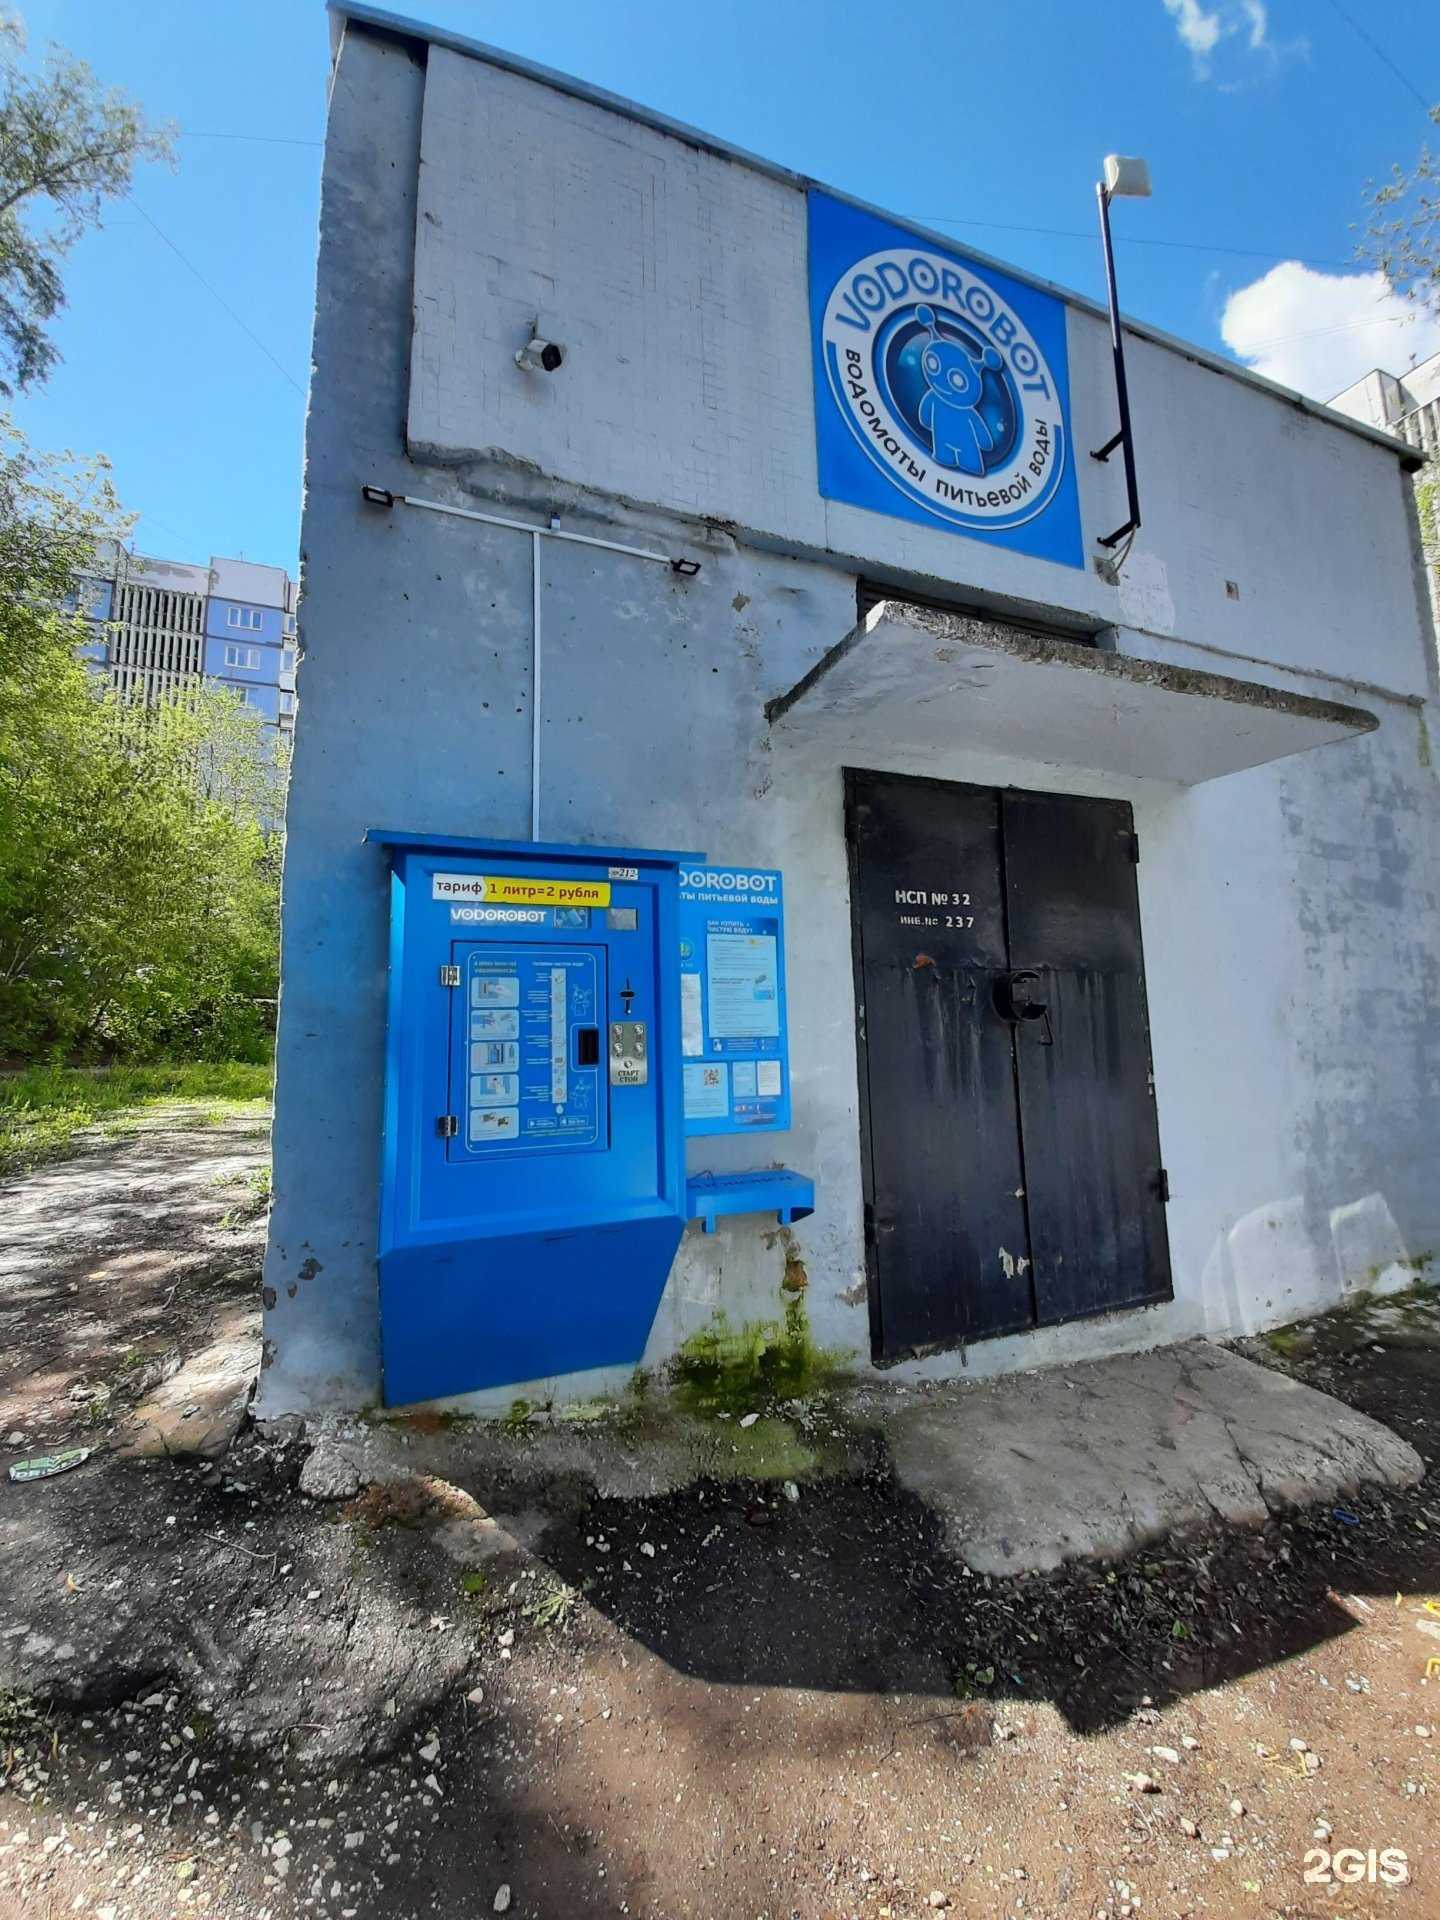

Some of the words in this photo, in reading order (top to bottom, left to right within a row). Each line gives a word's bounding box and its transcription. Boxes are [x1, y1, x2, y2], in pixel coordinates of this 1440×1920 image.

[835, 257, 1051, 401] VODOROBOT
[436, 881, 483, 895] тариф
[489, 883, 497, 894] 1
[559, 886, 599, 899] рубля
[895, 890, 927, 905] НСП
[951, 893, 971, 906] 32
[750, 894, 778, 905] ВОДЫ
[450, 907, 547, 923] VODOROBOT
[945, 915, 975, 929] 237
